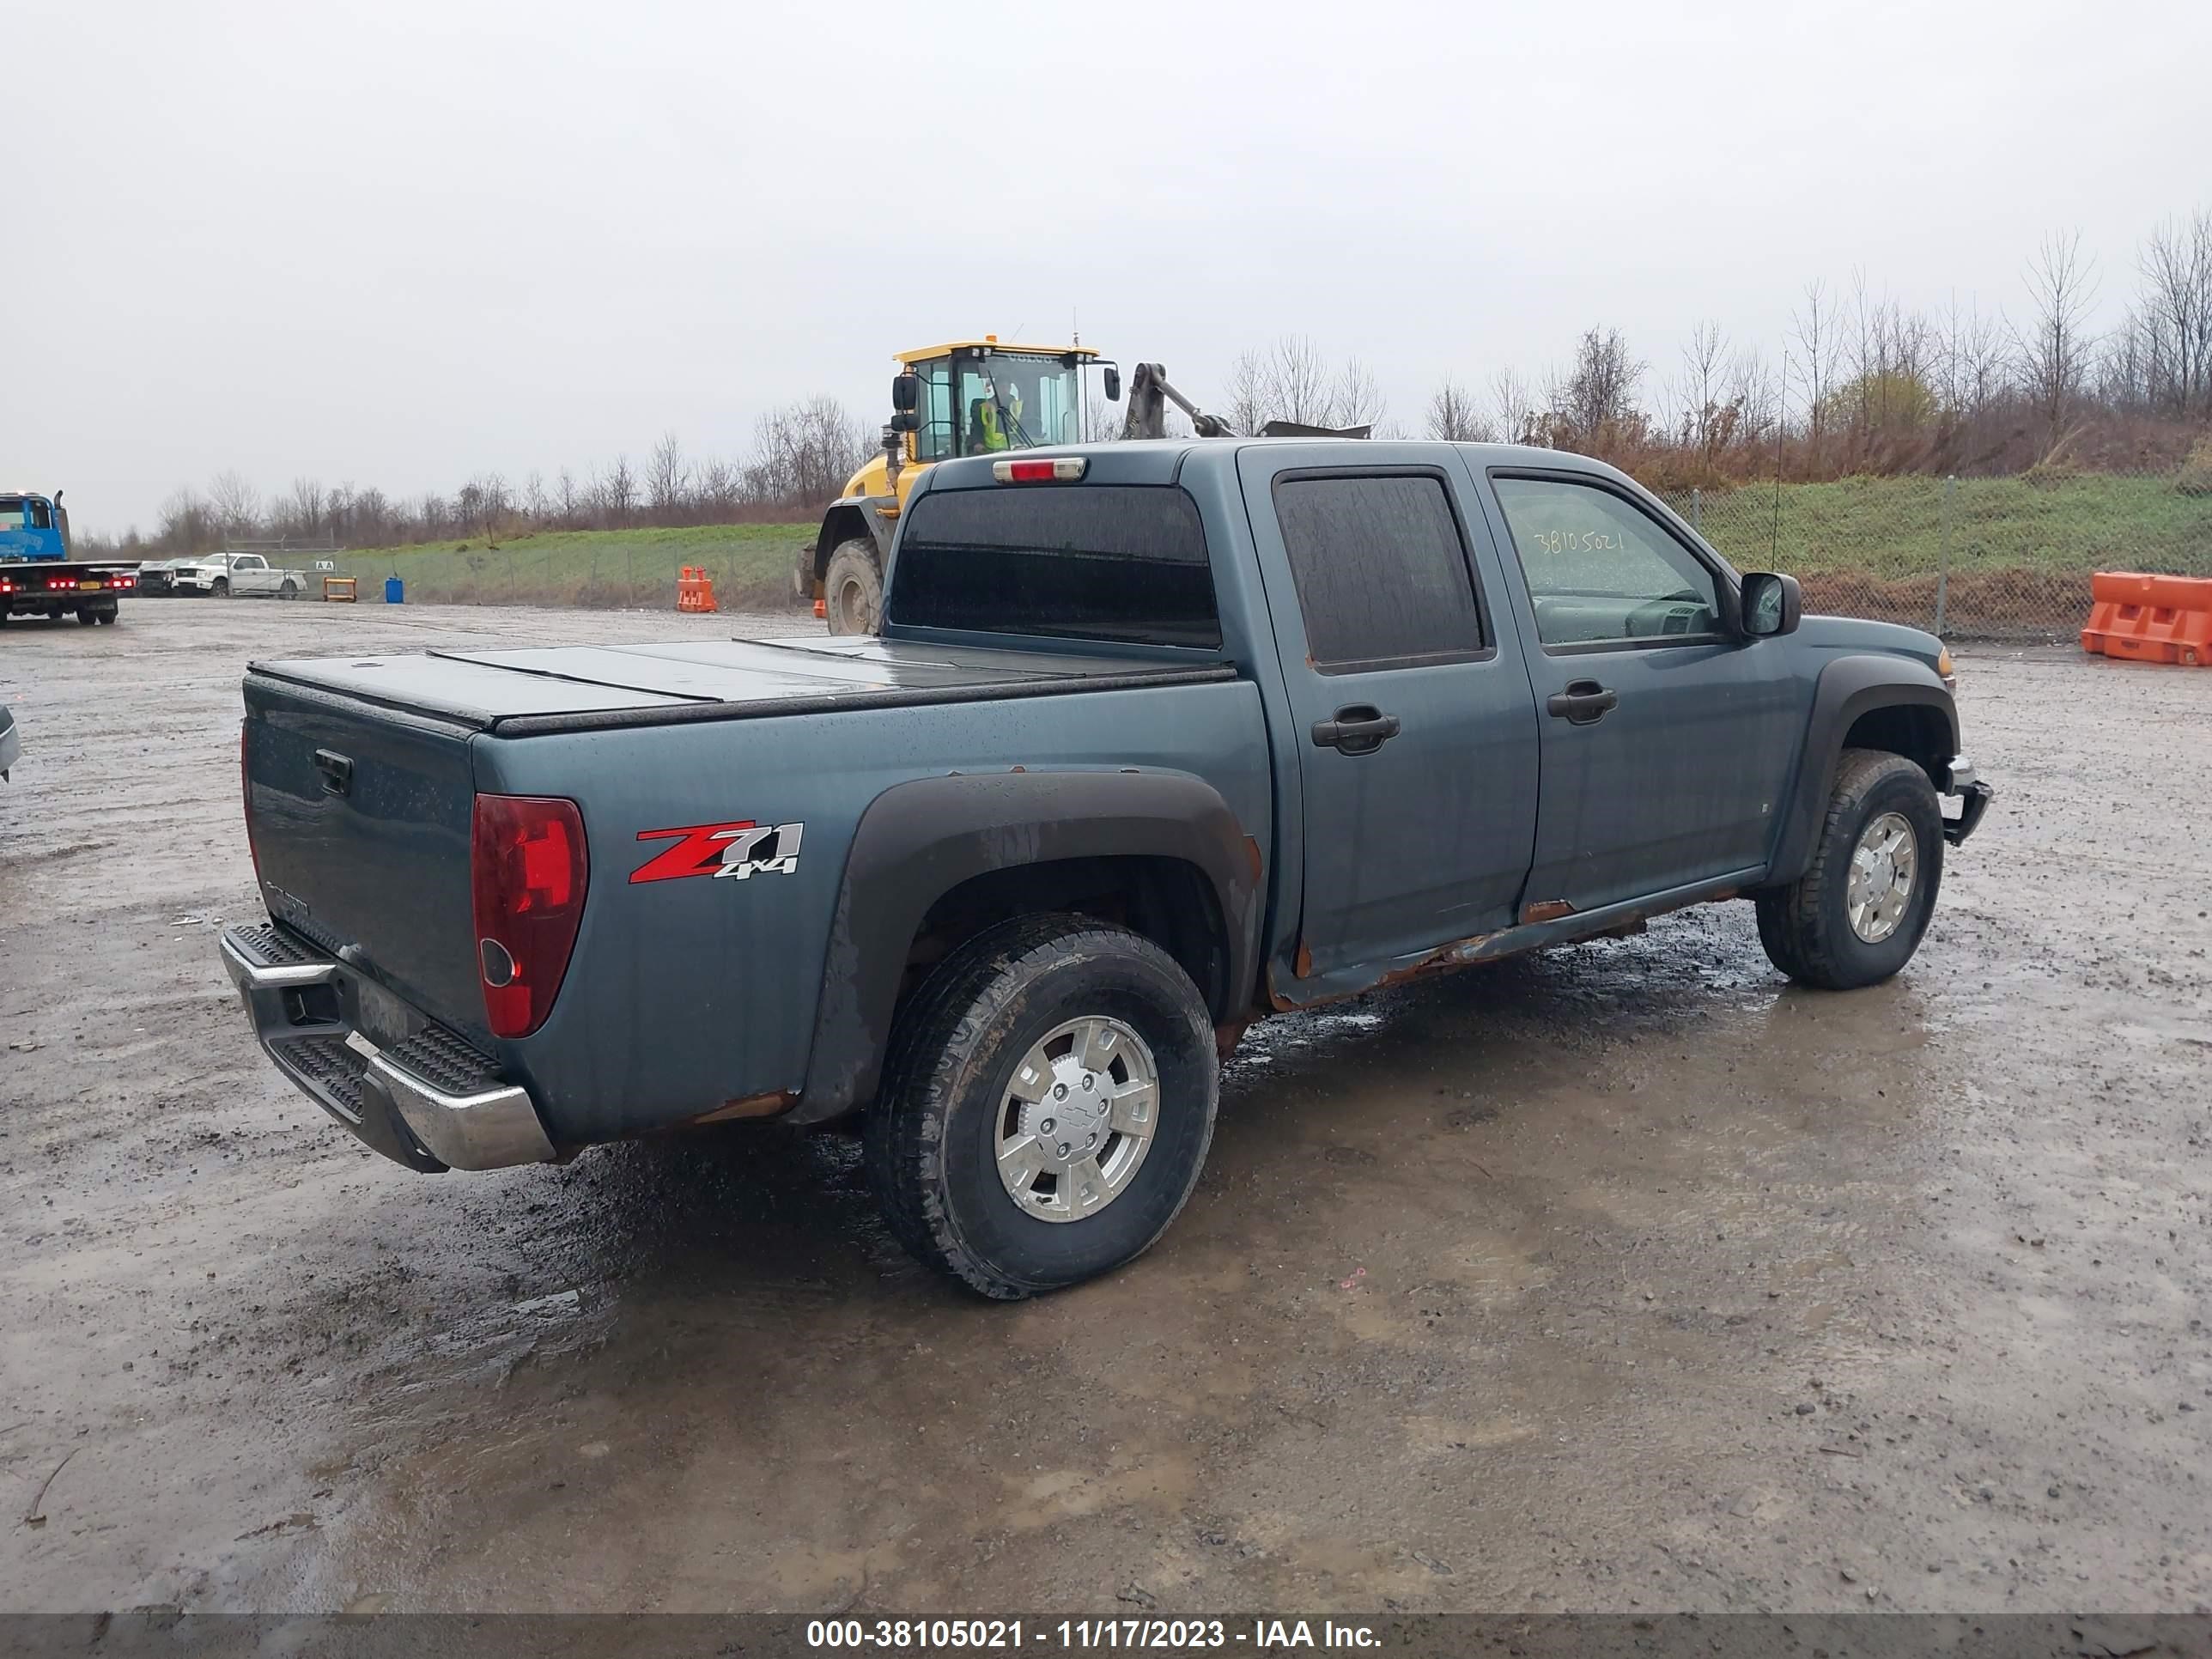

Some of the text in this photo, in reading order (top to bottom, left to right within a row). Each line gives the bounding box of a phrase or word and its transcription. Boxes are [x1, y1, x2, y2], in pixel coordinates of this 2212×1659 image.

[1009, 355, 1052, 364] VOLVO
[1534, 531, 1624, 554] 38105021
[629, 819, 805, 884] Z71
[712, 857, 798, 881] 4x4
